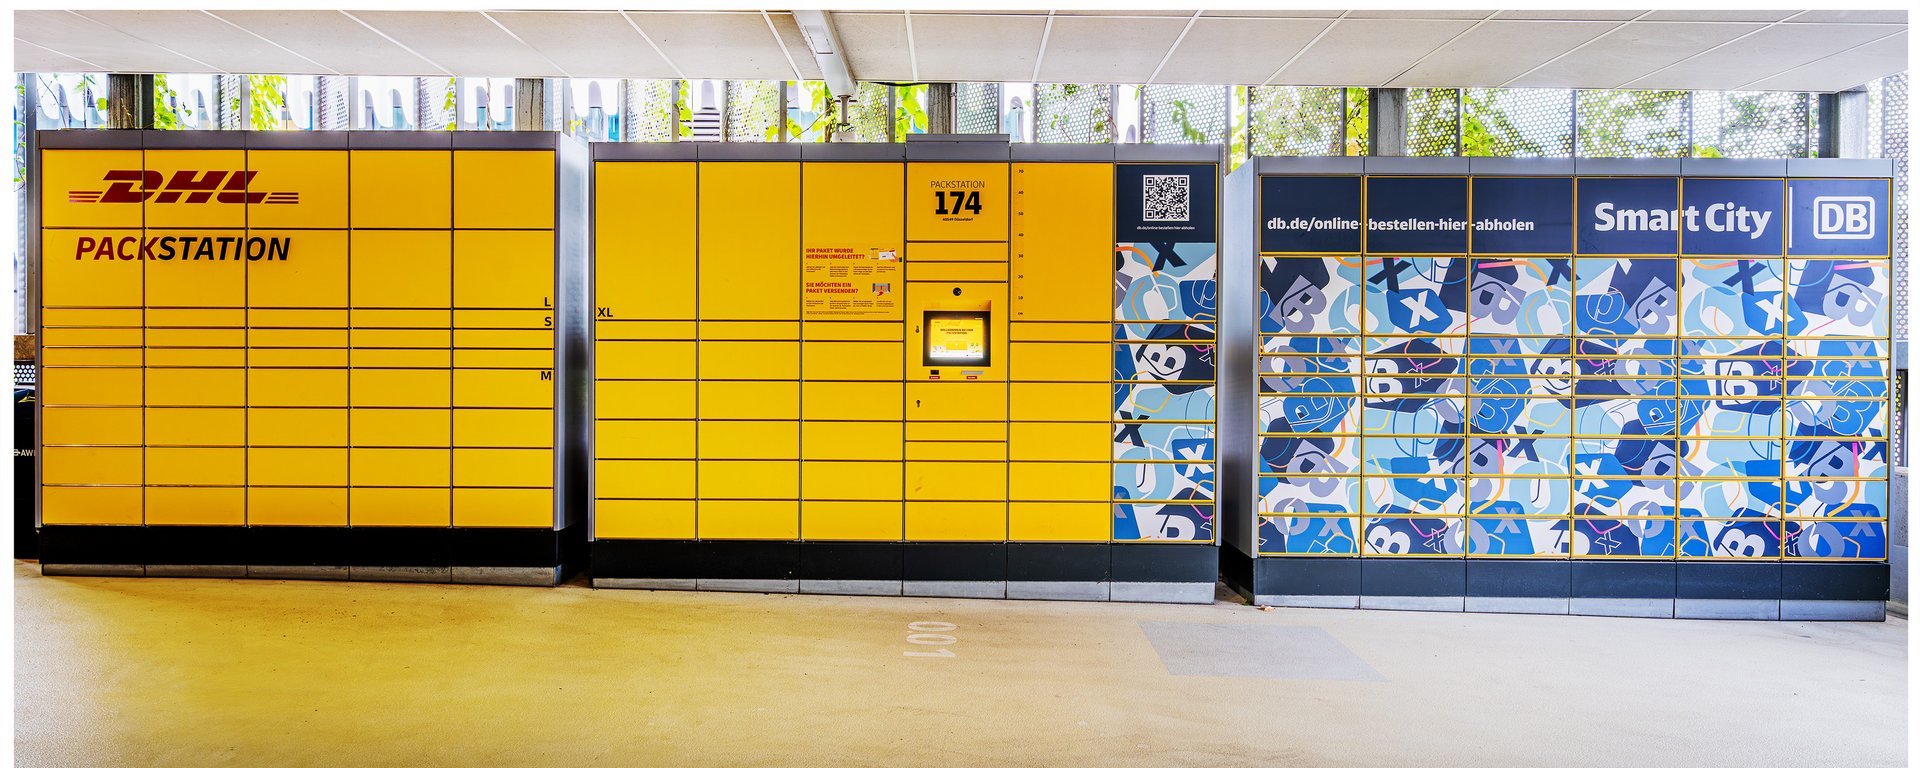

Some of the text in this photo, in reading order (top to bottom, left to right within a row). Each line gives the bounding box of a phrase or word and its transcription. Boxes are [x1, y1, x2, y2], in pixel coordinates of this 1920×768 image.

[99, 170, 268, 204] DHL
[930, 180, 985, 189] PACKSTATION
[935, 191, 983, 215] 174
[1594, 201, 1772, 240] Smart City
[1820, 203, 1868, 233] DB
[75, 236, 291, 261] PACKSTATION
[544, 297, 551, 307] L
[597, 307, 614, 318] XL
[544, 316, 552, 327] S
[540, 371, 552, 381] M
